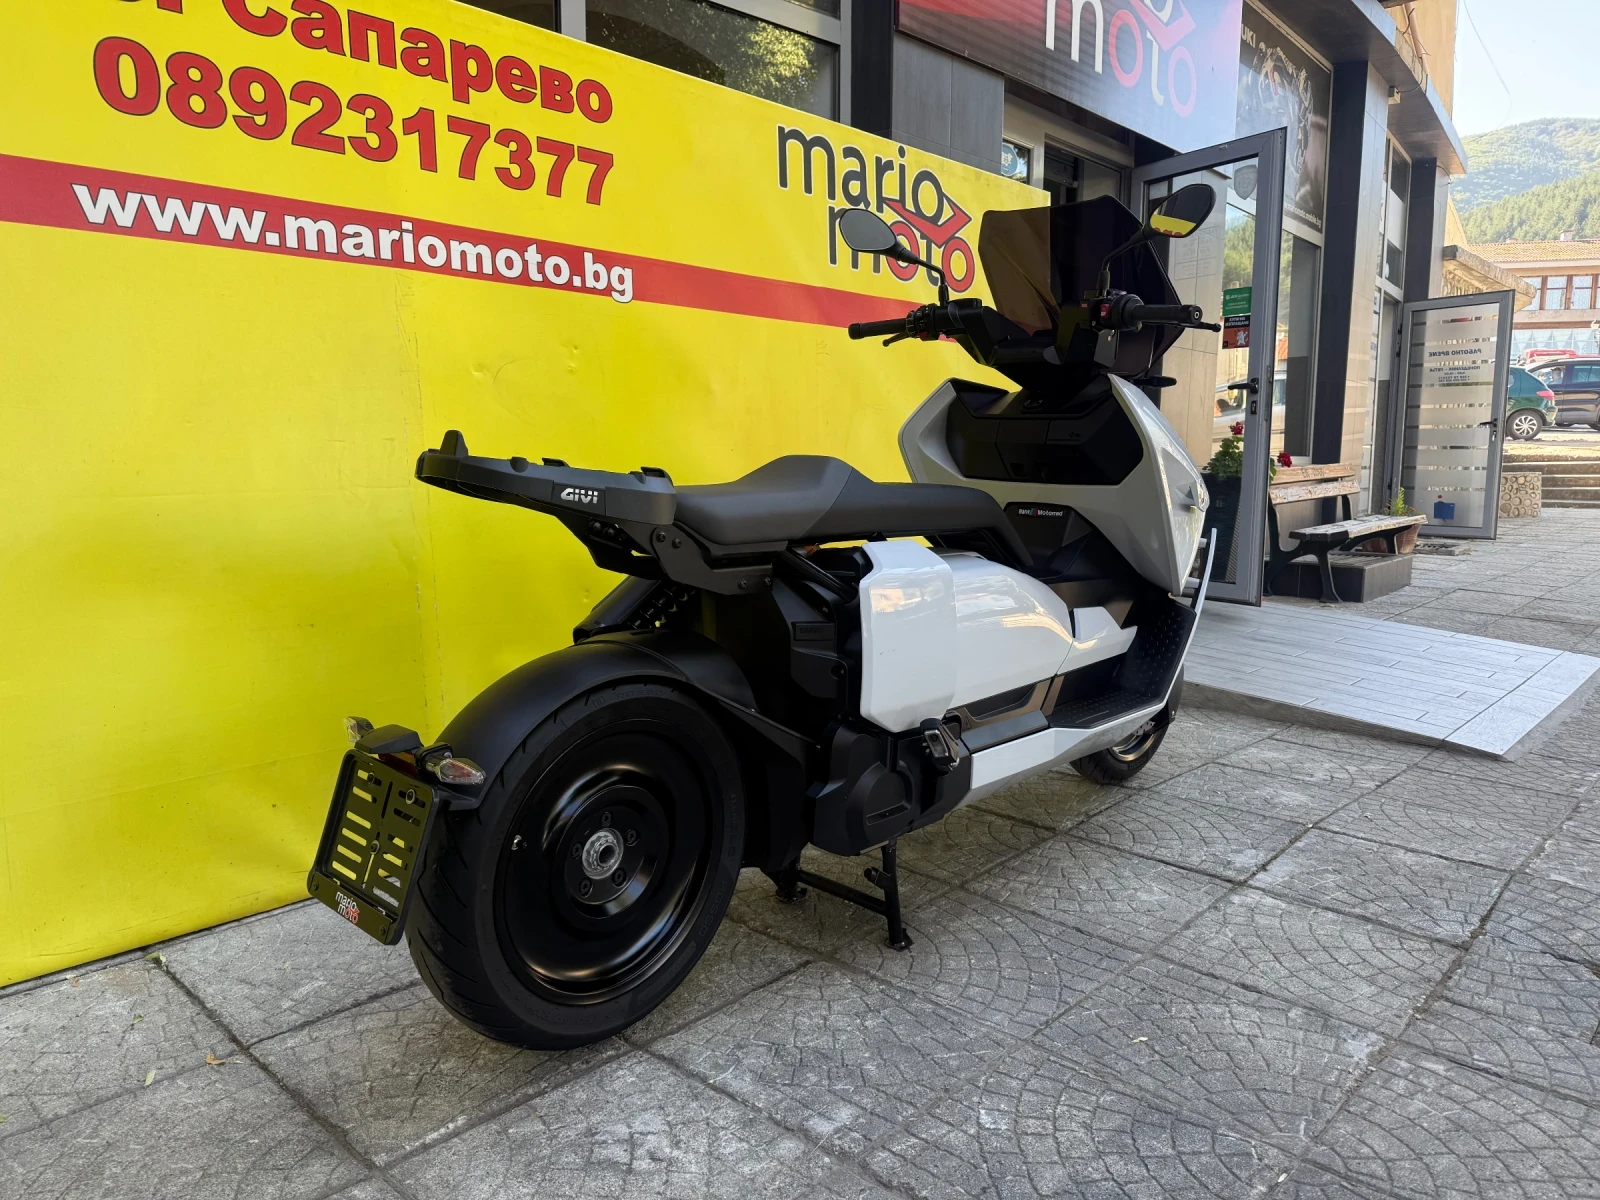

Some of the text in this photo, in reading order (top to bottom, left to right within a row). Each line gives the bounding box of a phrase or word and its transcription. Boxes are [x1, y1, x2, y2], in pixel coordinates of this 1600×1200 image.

[1045, 0, 1197, 118] moto
[92, 36, 615, 206] 0892317377
[777, 125, 944, 226] mario
[70, 183, 634, 304] www.mariomoto.bg
[335, 891, 358, 910] mario
[337, 903, 359, 924] moto
